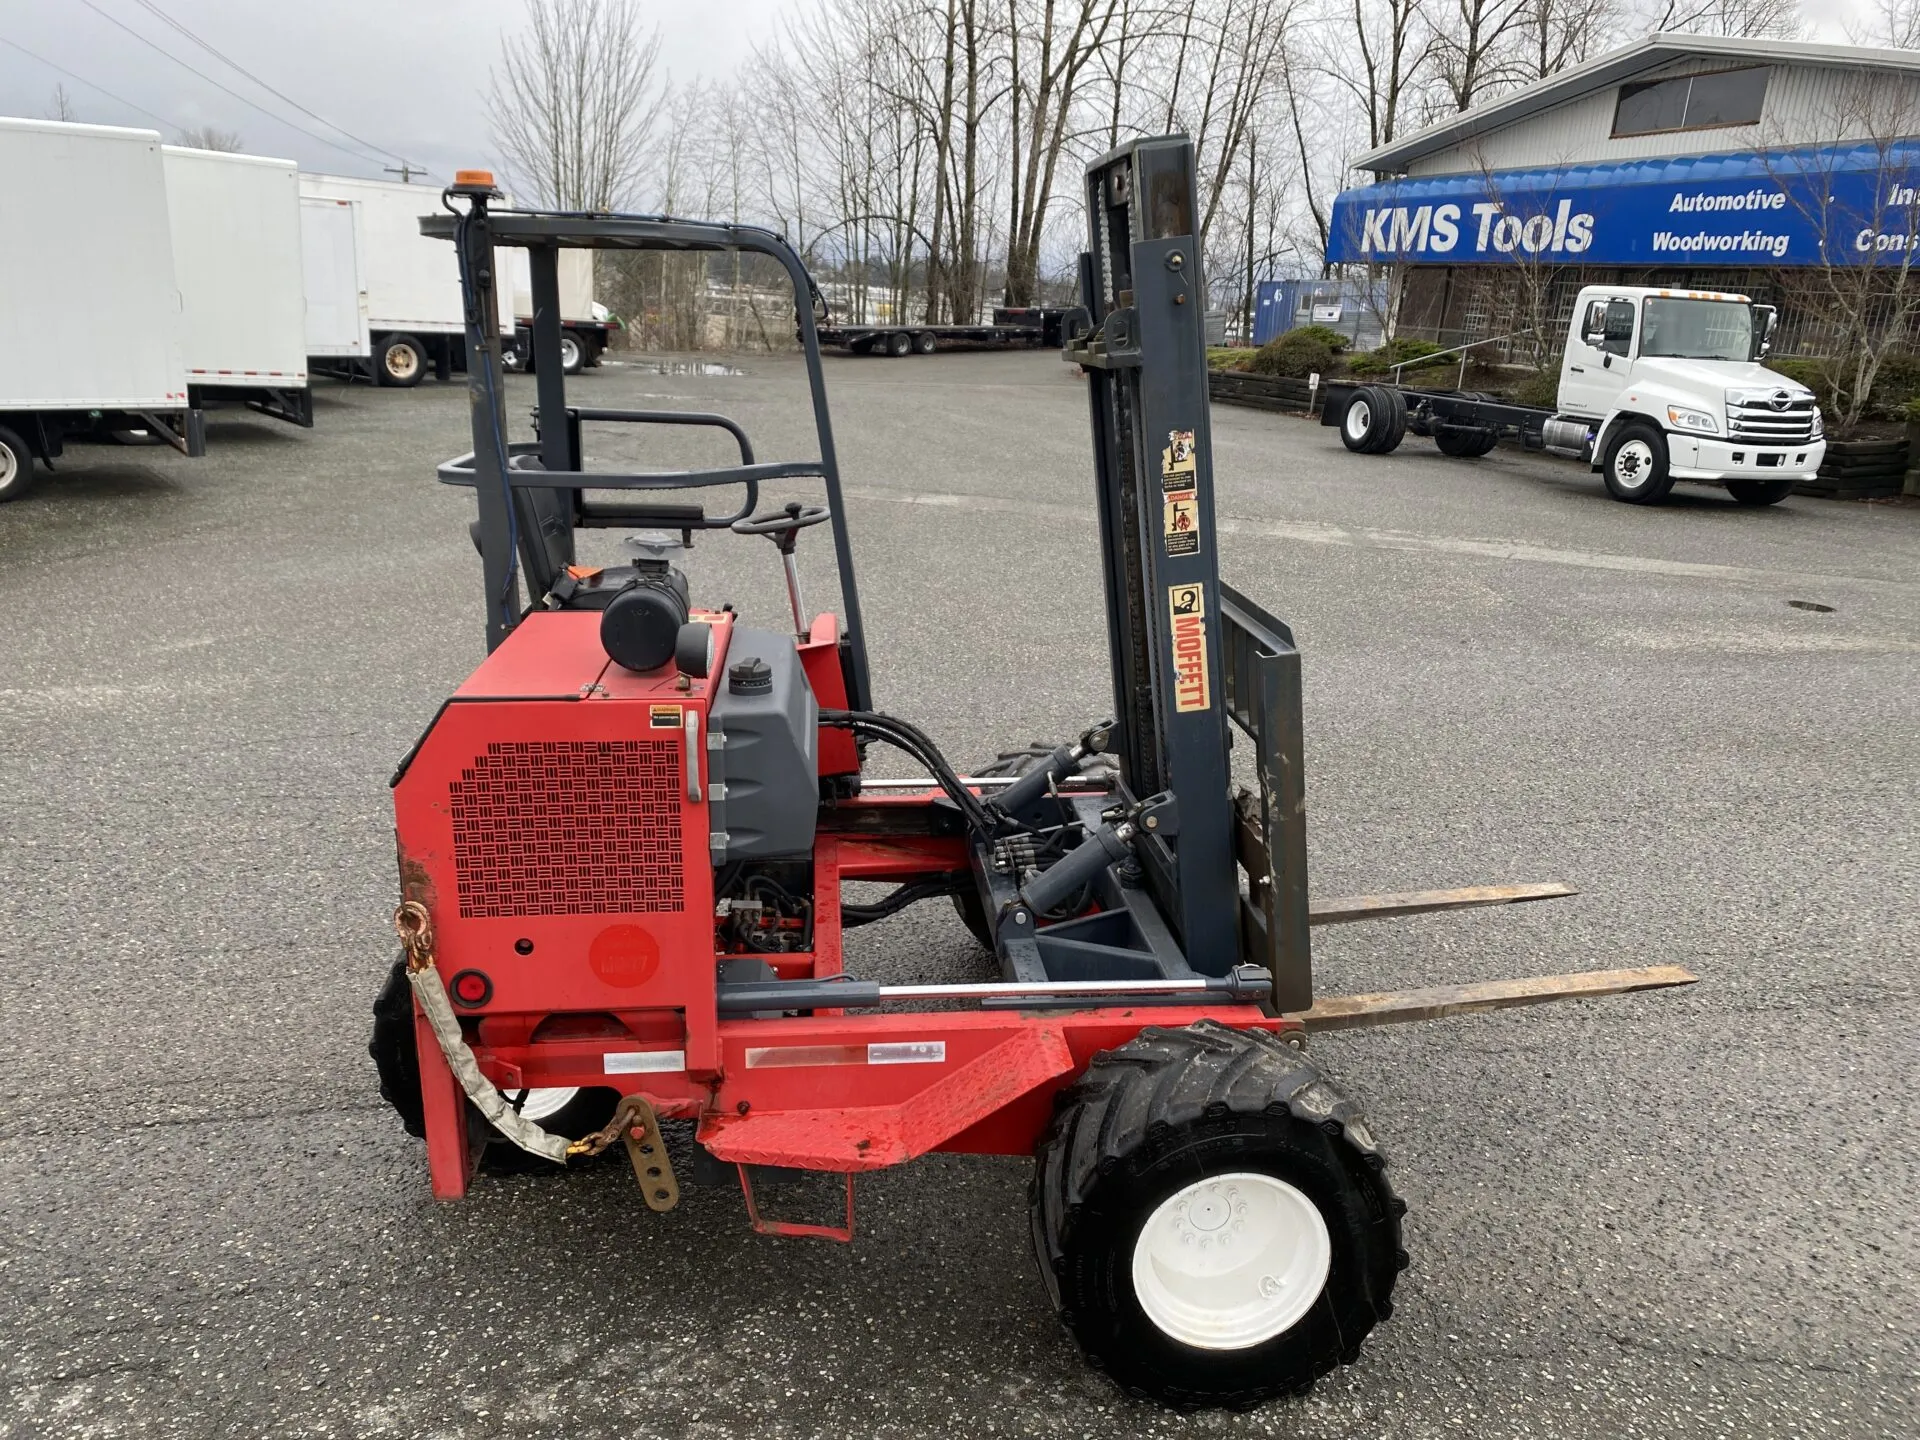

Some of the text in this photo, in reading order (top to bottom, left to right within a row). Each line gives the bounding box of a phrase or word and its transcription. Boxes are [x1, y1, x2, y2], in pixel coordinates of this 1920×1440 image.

[1669, 189, 1786, 213] Automotive
[1361, 199, 1595, 252] KMS Tools
[1653, 230, 1790, 257] Woodworking
[1176, 616, 1204, 707] MOFFETT
